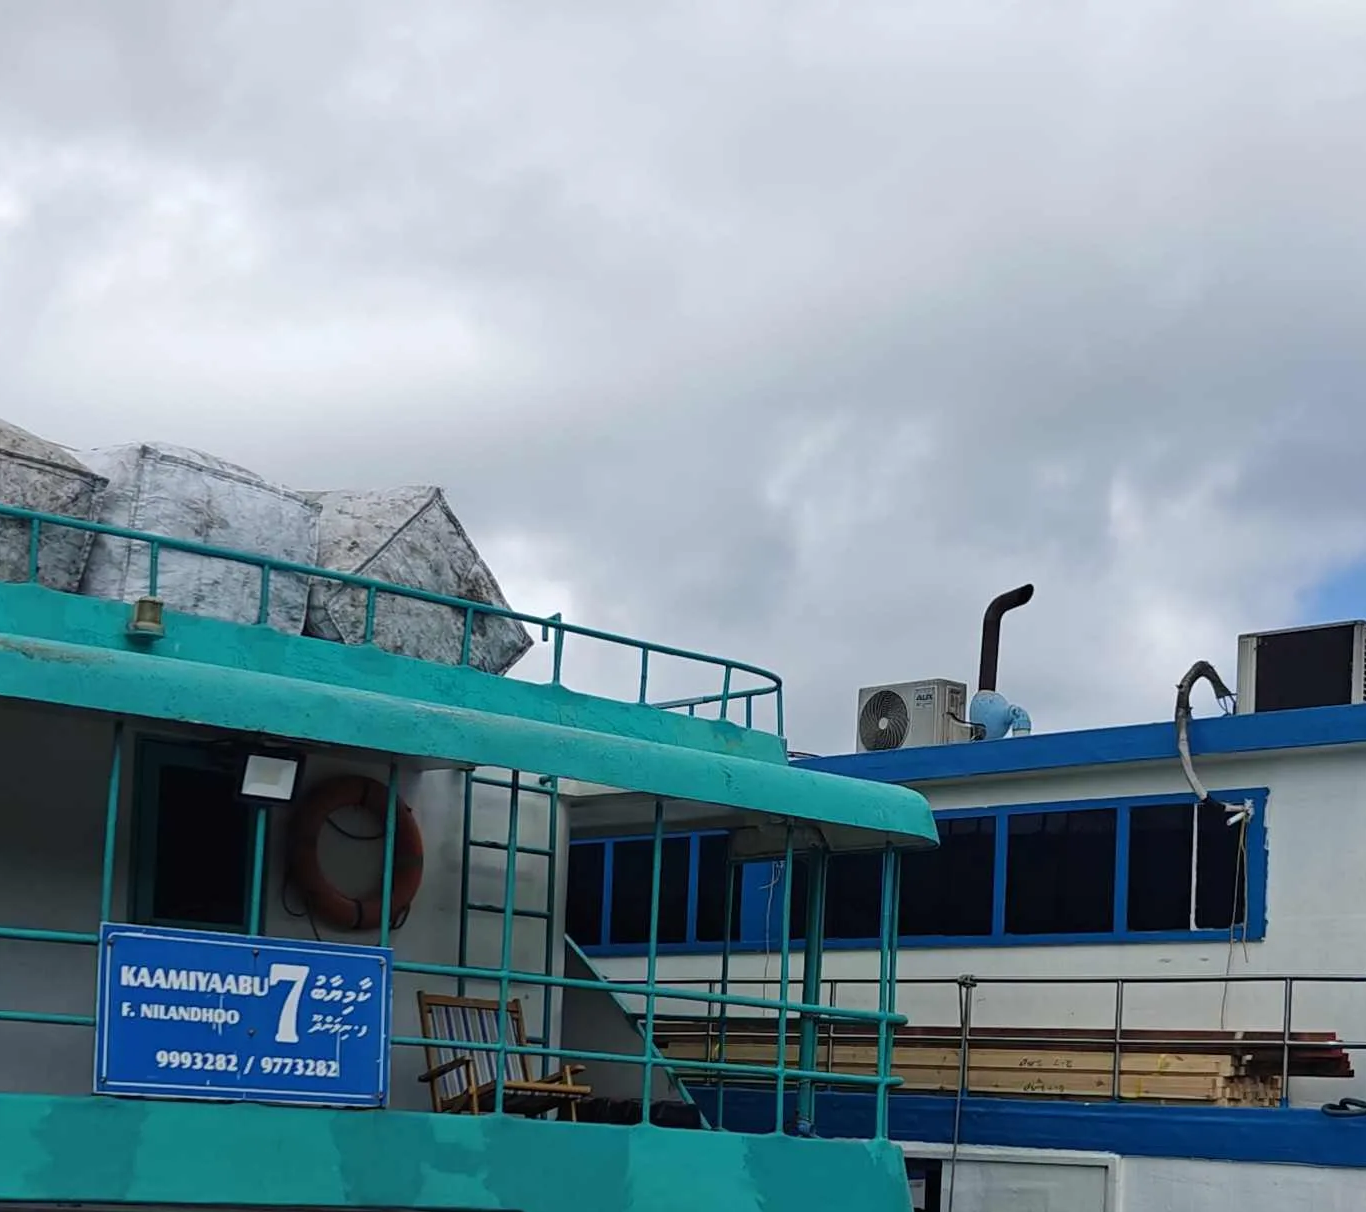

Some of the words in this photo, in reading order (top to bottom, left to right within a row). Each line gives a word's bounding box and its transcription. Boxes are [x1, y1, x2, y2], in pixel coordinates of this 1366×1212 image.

[120, 965, 270, 997] KAAMIYAABU
[269, 963, 310, 1044] 7
[121, 1002, 135, 1018] F.
[140, 1003, 241, 1025] NILANDHOO
[155, 1050, 238, 1072] 9993282
[243, 1056, 255, 1075] /
[260, 1056, 339, 1078] 9773282
